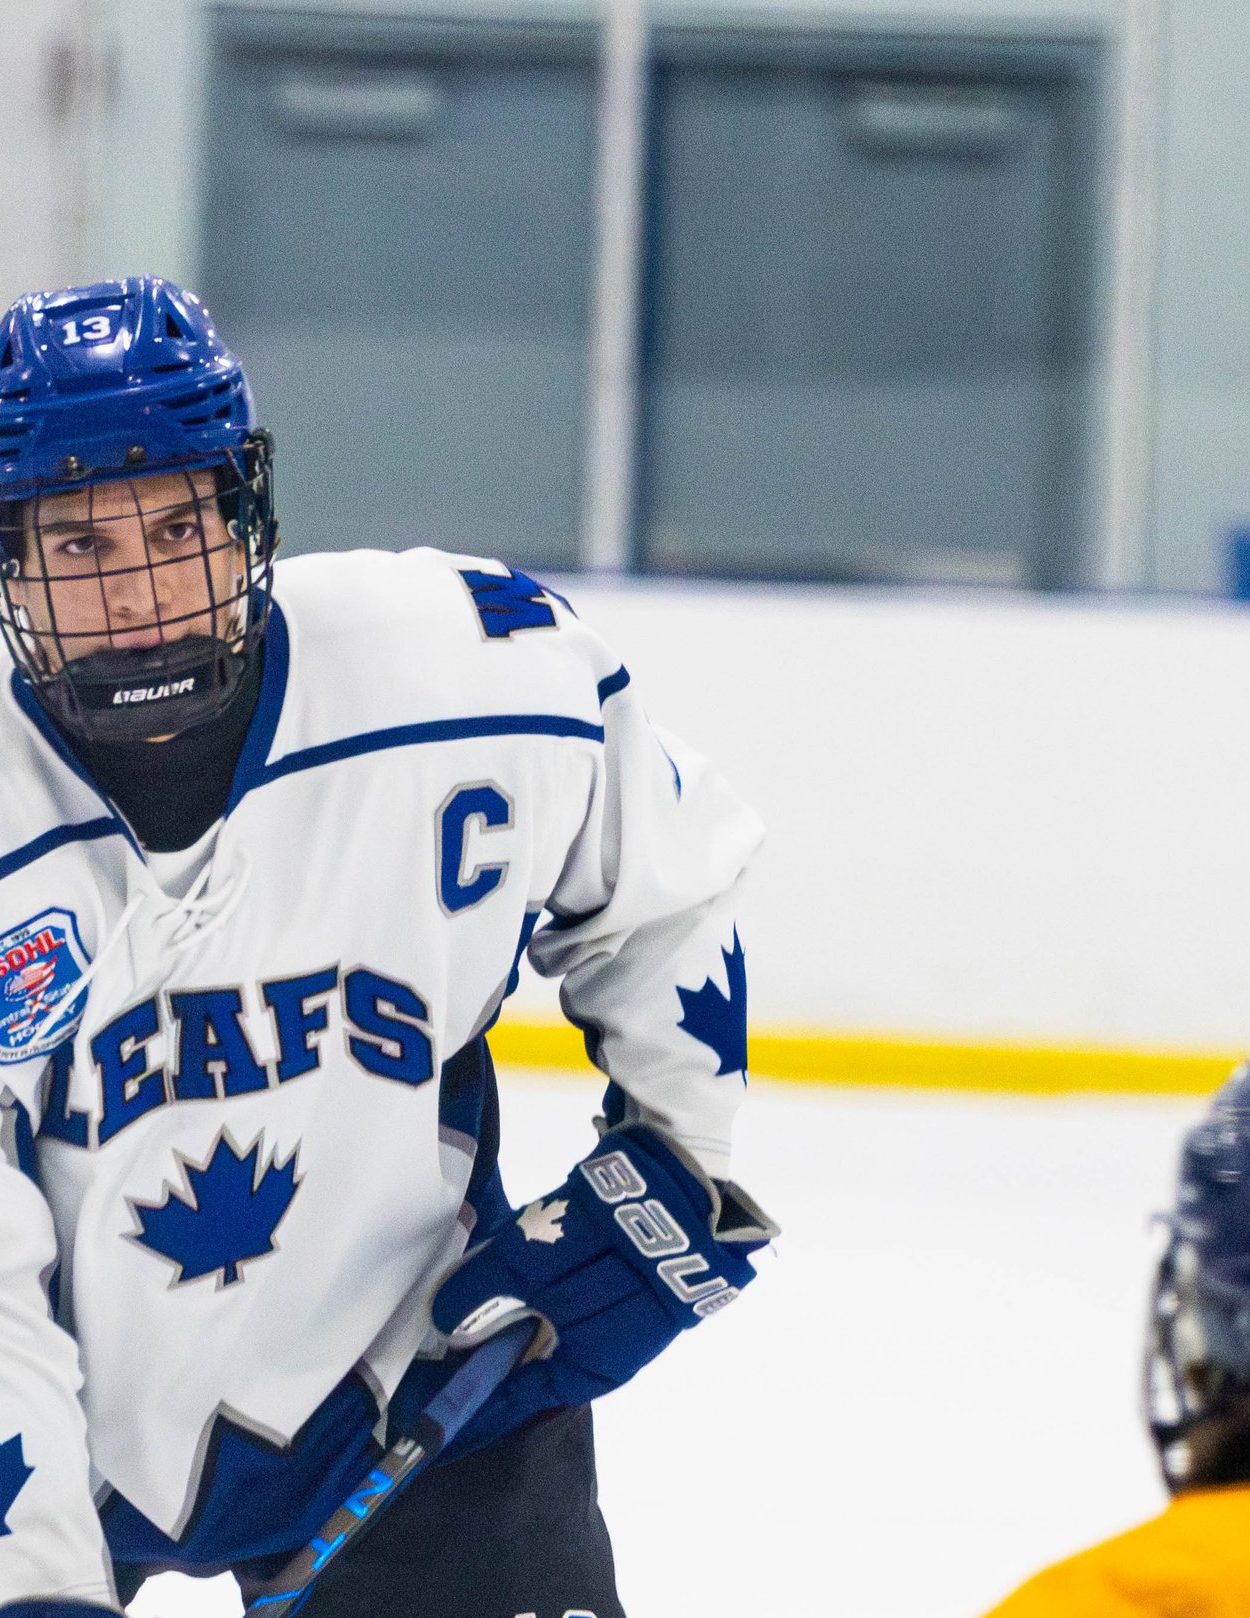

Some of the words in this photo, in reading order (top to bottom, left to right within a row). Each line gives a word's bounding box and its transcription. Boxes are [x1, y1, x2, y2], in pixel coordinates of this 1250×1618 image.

[62, 315, 111, 345] 13
[435, 779, 515, 919] C
[38, 963, 437, 1151] LEAFS
